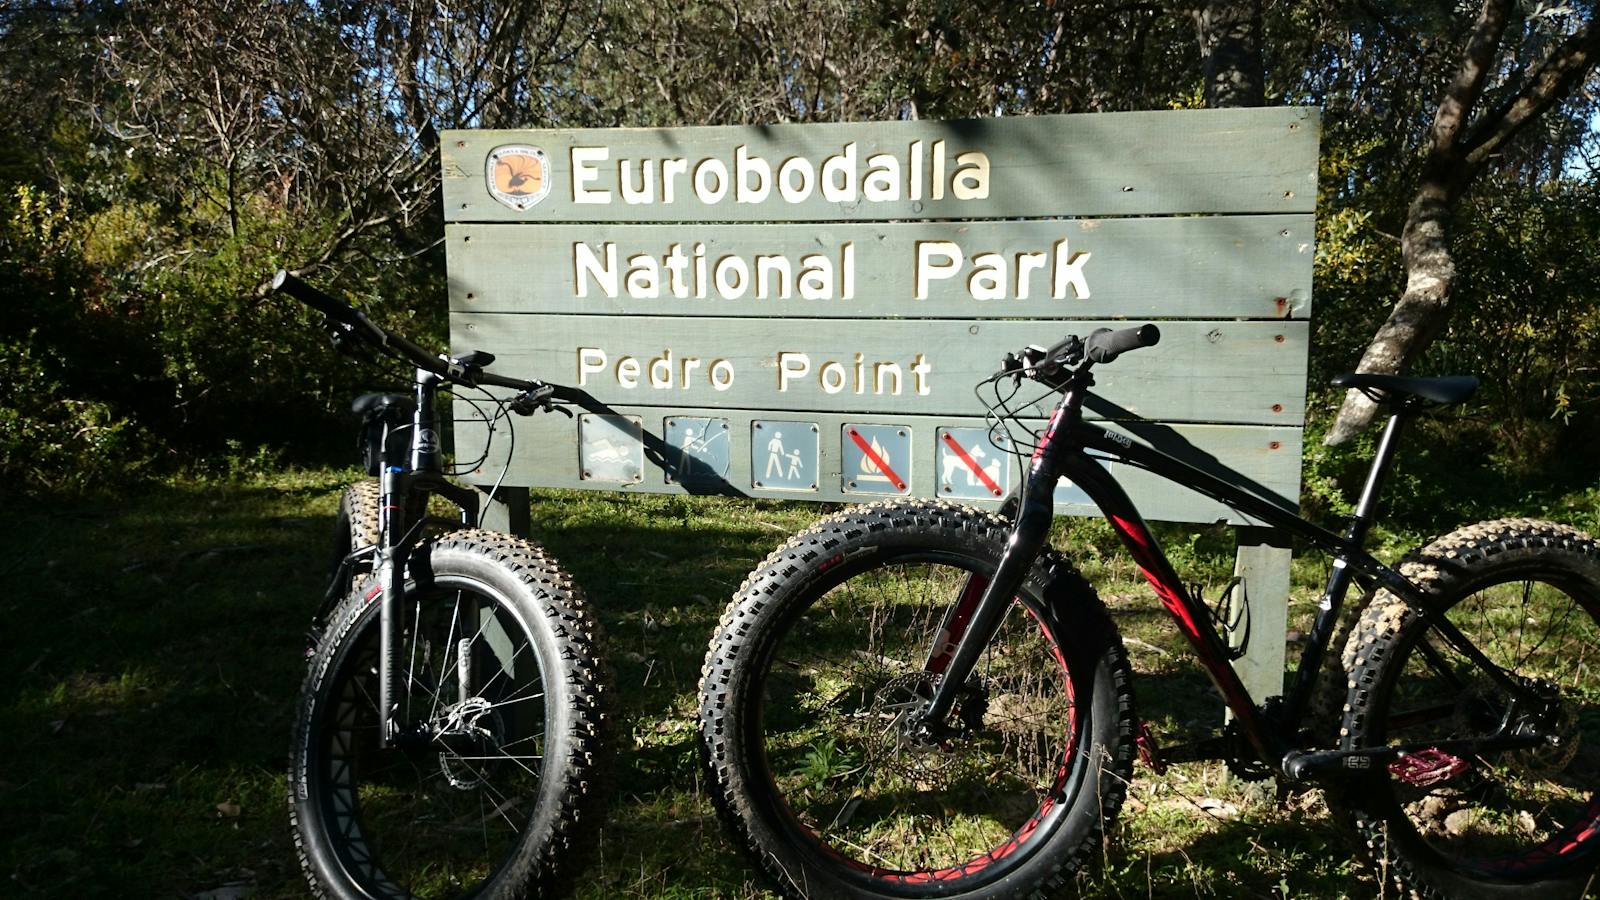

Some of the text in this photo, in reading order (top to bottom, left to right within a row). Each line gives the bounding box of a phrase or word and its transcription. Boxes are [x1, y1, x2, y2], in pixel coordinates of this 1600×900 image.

[570, 139, 990, 205] Eurobodalla
[572, 237, 1092, 300] National Park
[577, 347, 931, 396] Pedro Point
